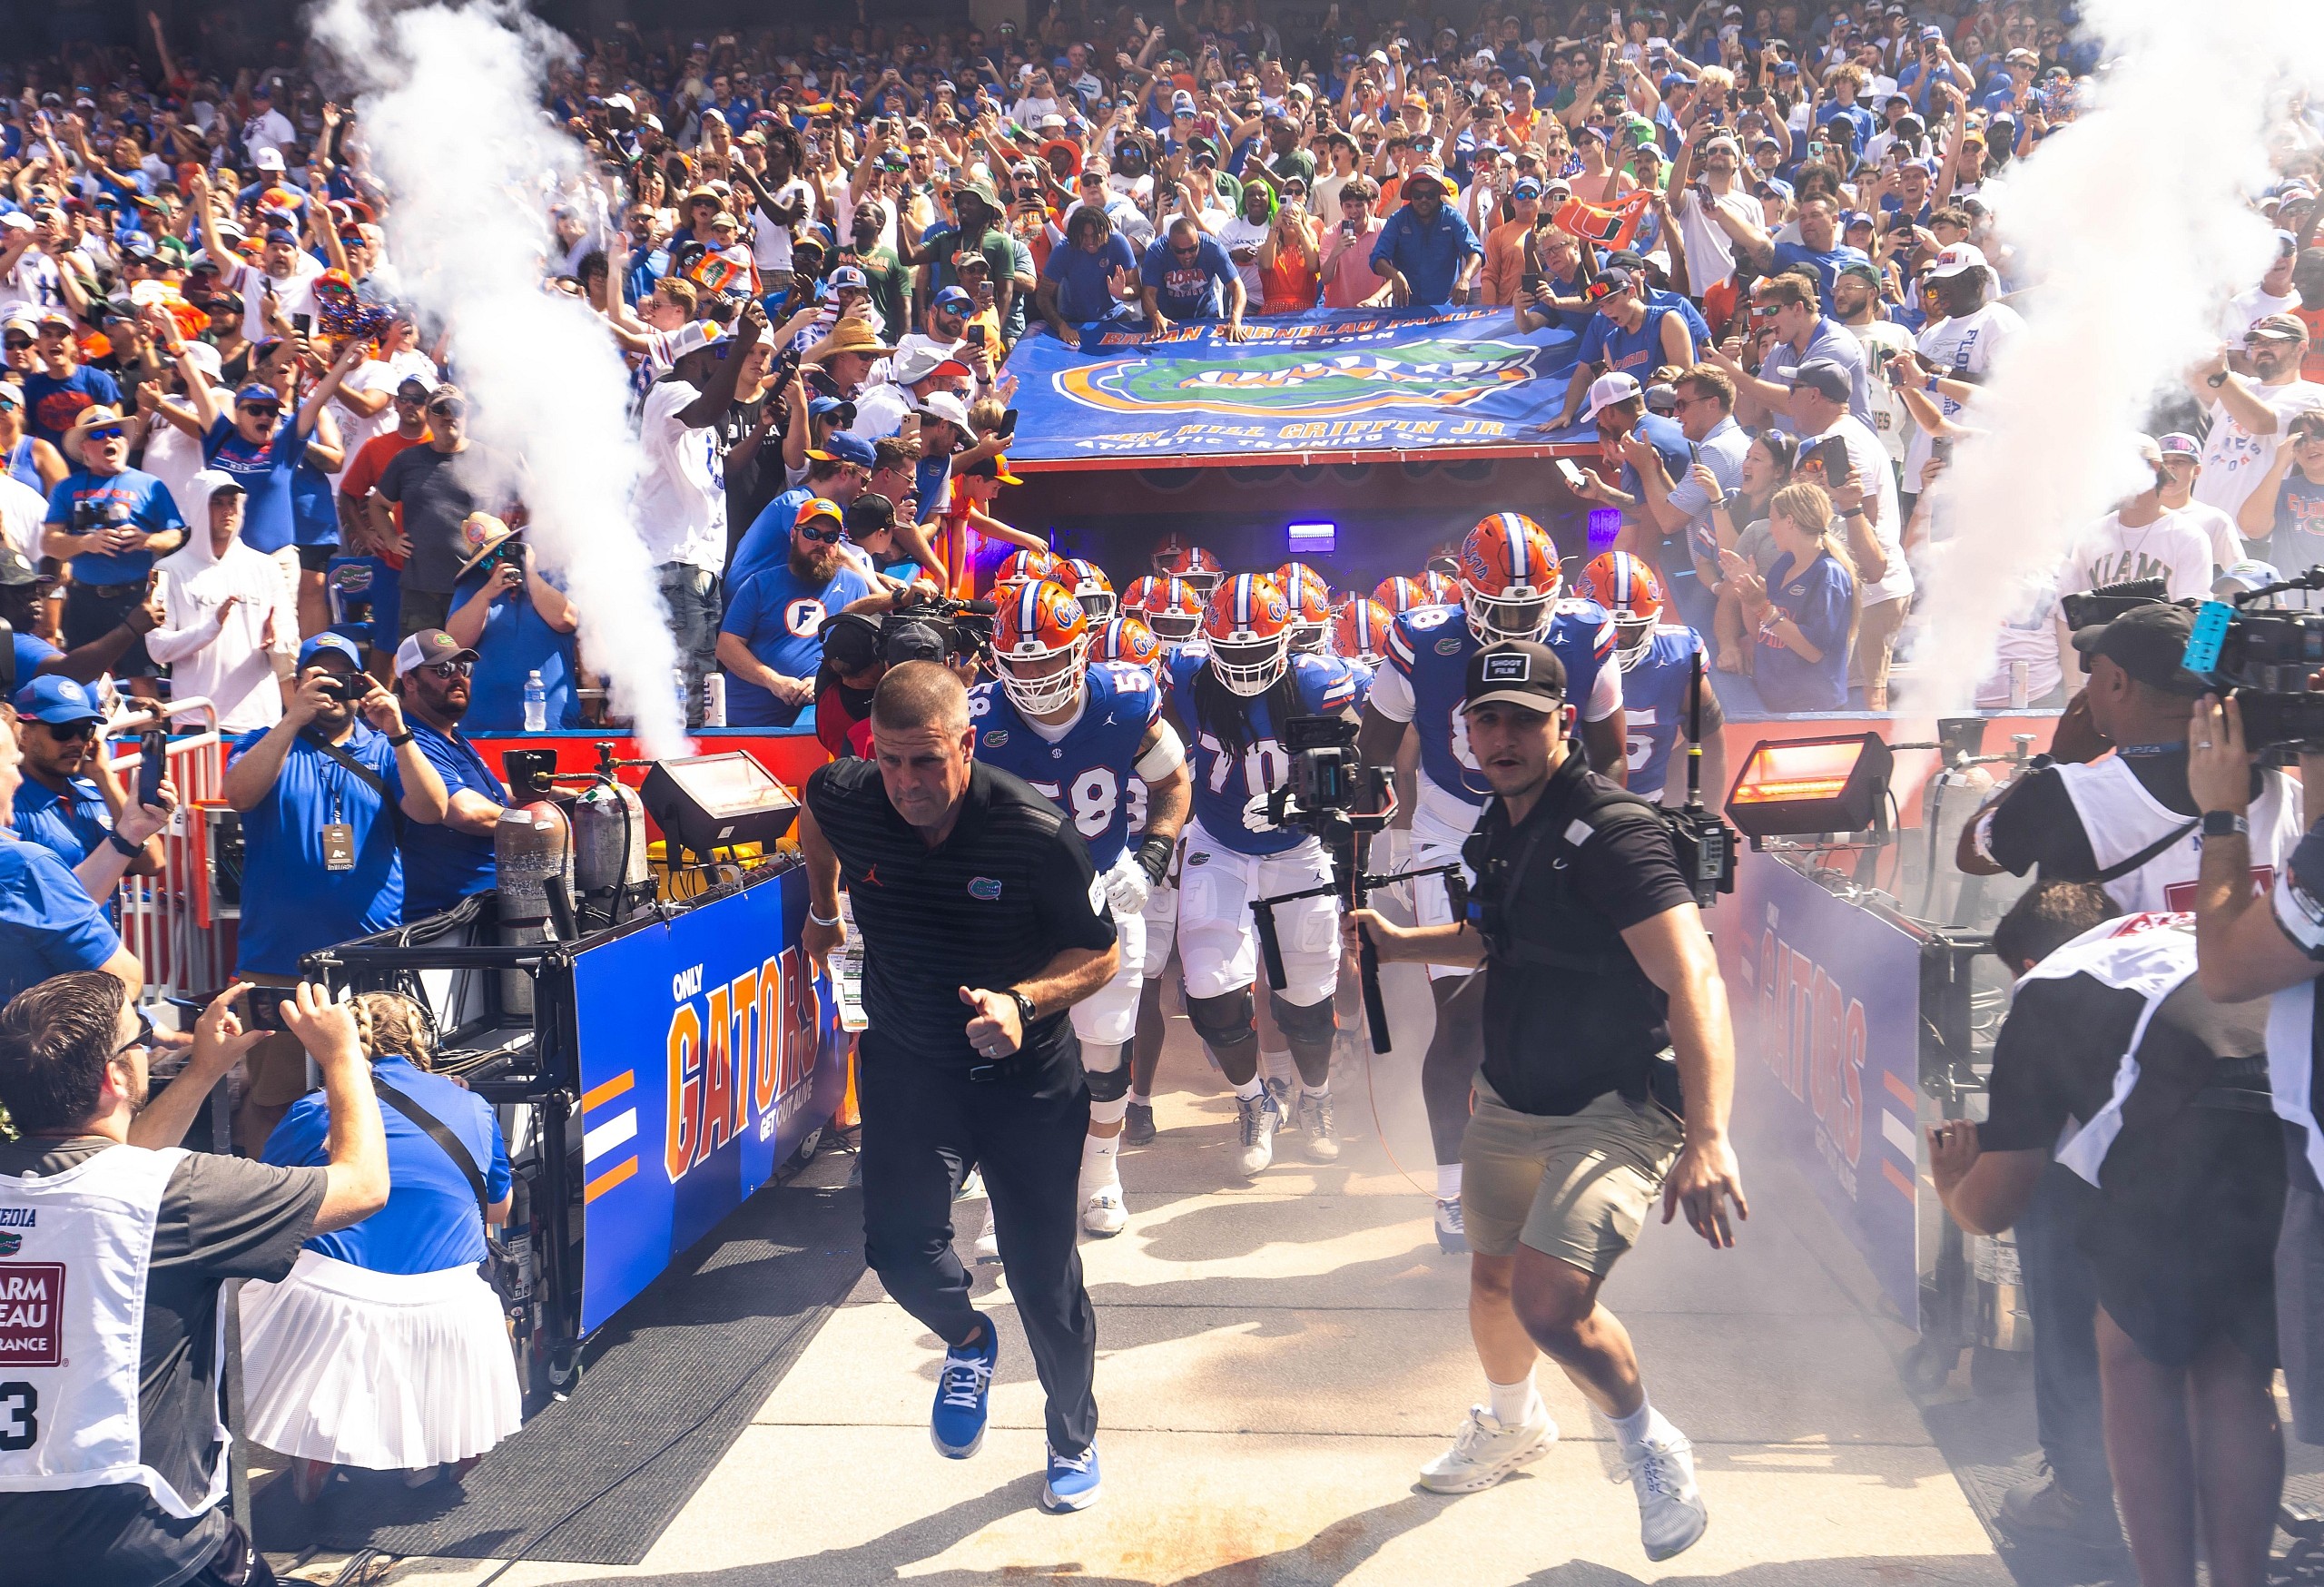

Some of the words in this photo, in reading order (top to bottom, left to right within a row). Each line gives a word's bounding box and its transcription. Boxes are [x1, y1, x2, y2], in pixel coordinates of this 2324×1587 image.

[1320, 330, 1396, 345] ROOM
[1172, 424, 1265, 438] HILL
[1276, 419, 1443, 439] GRIFFIN
[1075, 436, 1224, 451] ATHLETIC
[1237, 434, 1383, 449] TRAINING
[1396, 431, 1516, 445] CENT
[795, 605, 817, 630] F
[1490, 659, 1522, 667] SHOOT
[1196, 727, 1293, 799] 70
[673, 963, 704, 1002] ONLY
[665, 944, 821, 1185] GATORS
[759, 1108, 777, 1142] GET
[776, 1095, 794, 1128] OUT
[792, 1077, 812, 1113] ALIVE
[0, 1208, 36, 1227] EDIA
